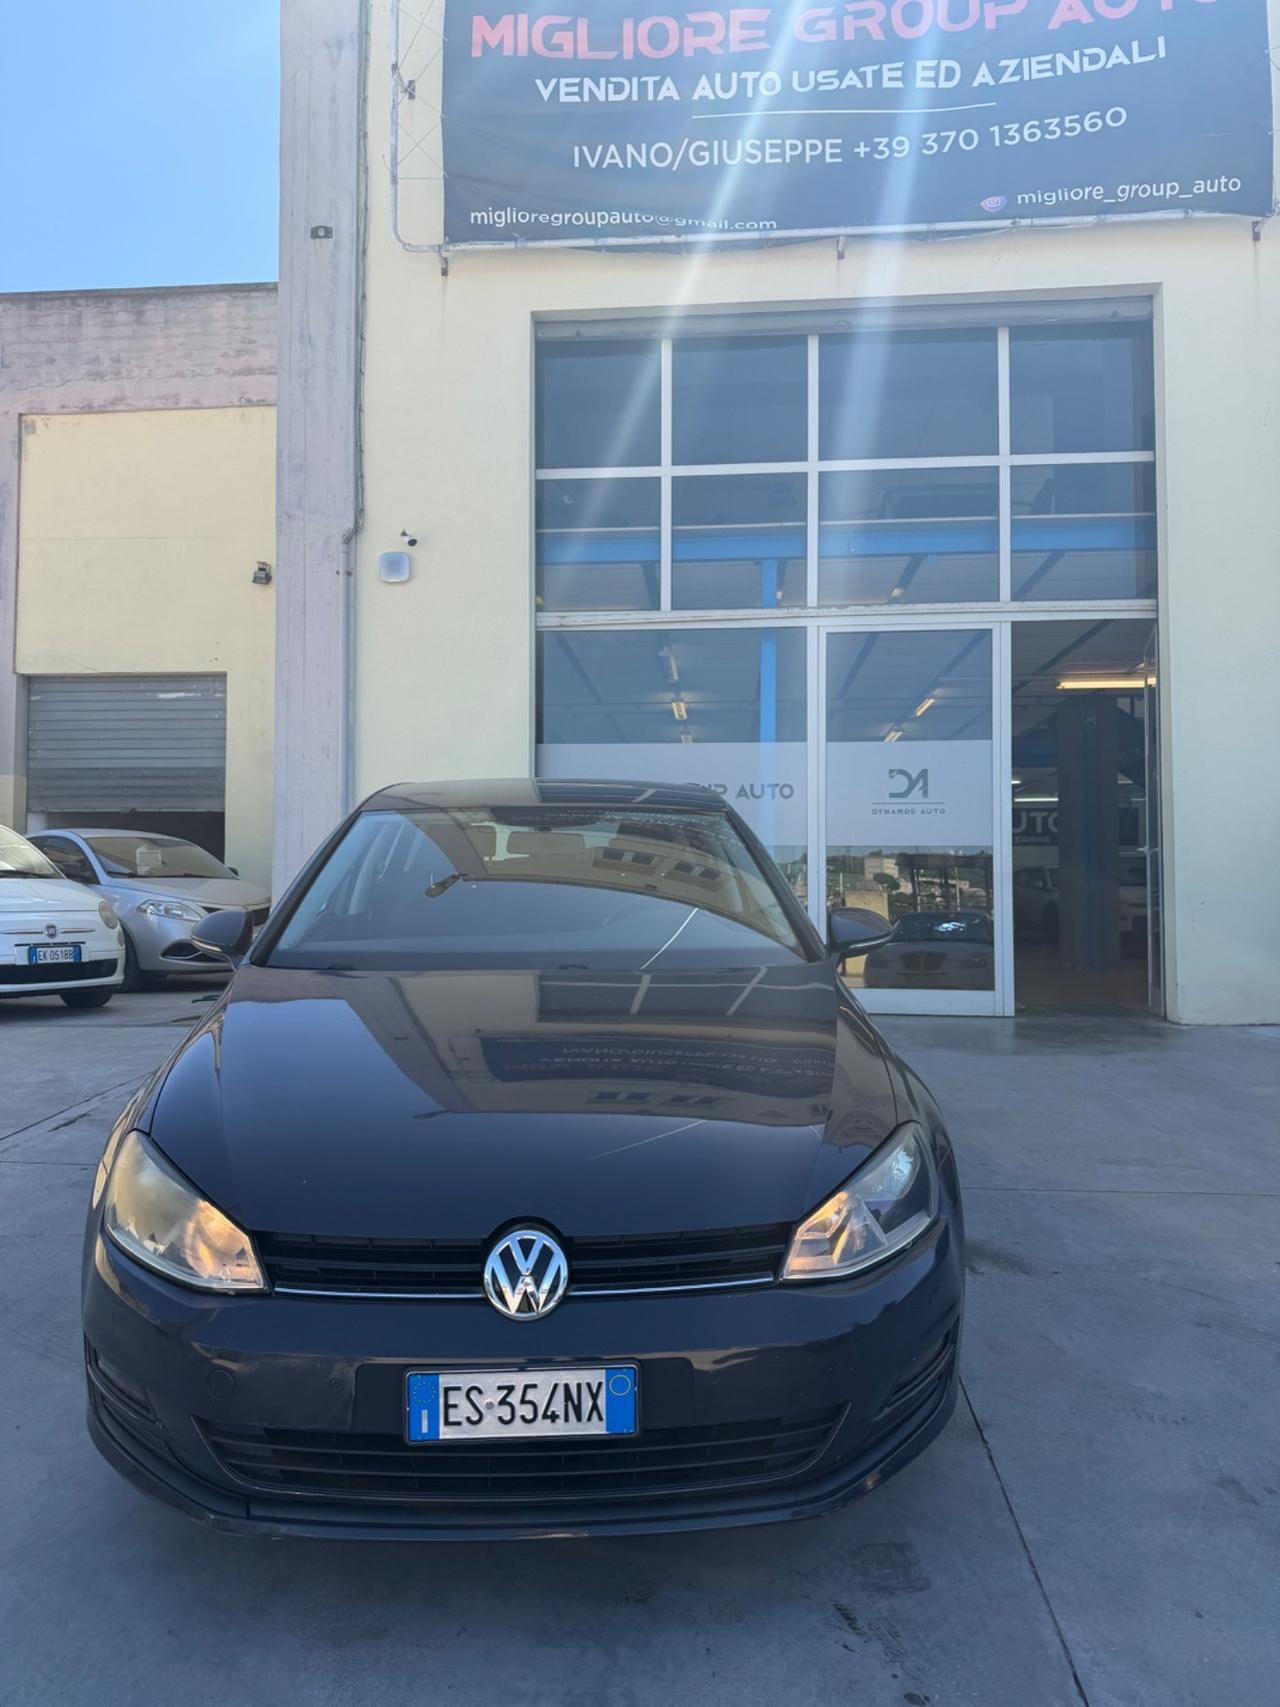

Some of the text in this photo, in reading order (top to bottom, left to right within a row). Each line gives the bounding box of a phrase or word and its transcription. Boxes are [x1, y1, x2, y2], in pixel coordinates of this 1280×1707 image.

[471, 9, 771, 60] MIGLIORE
[793, 0, 1028, 42] GROUP
[535, 35, 1167, 103] VENDITA AUTO USATE ED AZIENDALI
[573, 106, 1127, 171] IVANO/GIUSEPPE +39 370 1363560
[1017, 175, 1241, 206] migliore_group_auto
[470, 207, 777, 230] miglioregroupauto@gmail.com
[736, 783, 794, 800] AUTO
[871, 807, 946, 816] DYNAMOS AUTO
[443, 1385, 484, 1426] ES
[497, 1381, 604, 1425] 354NX
